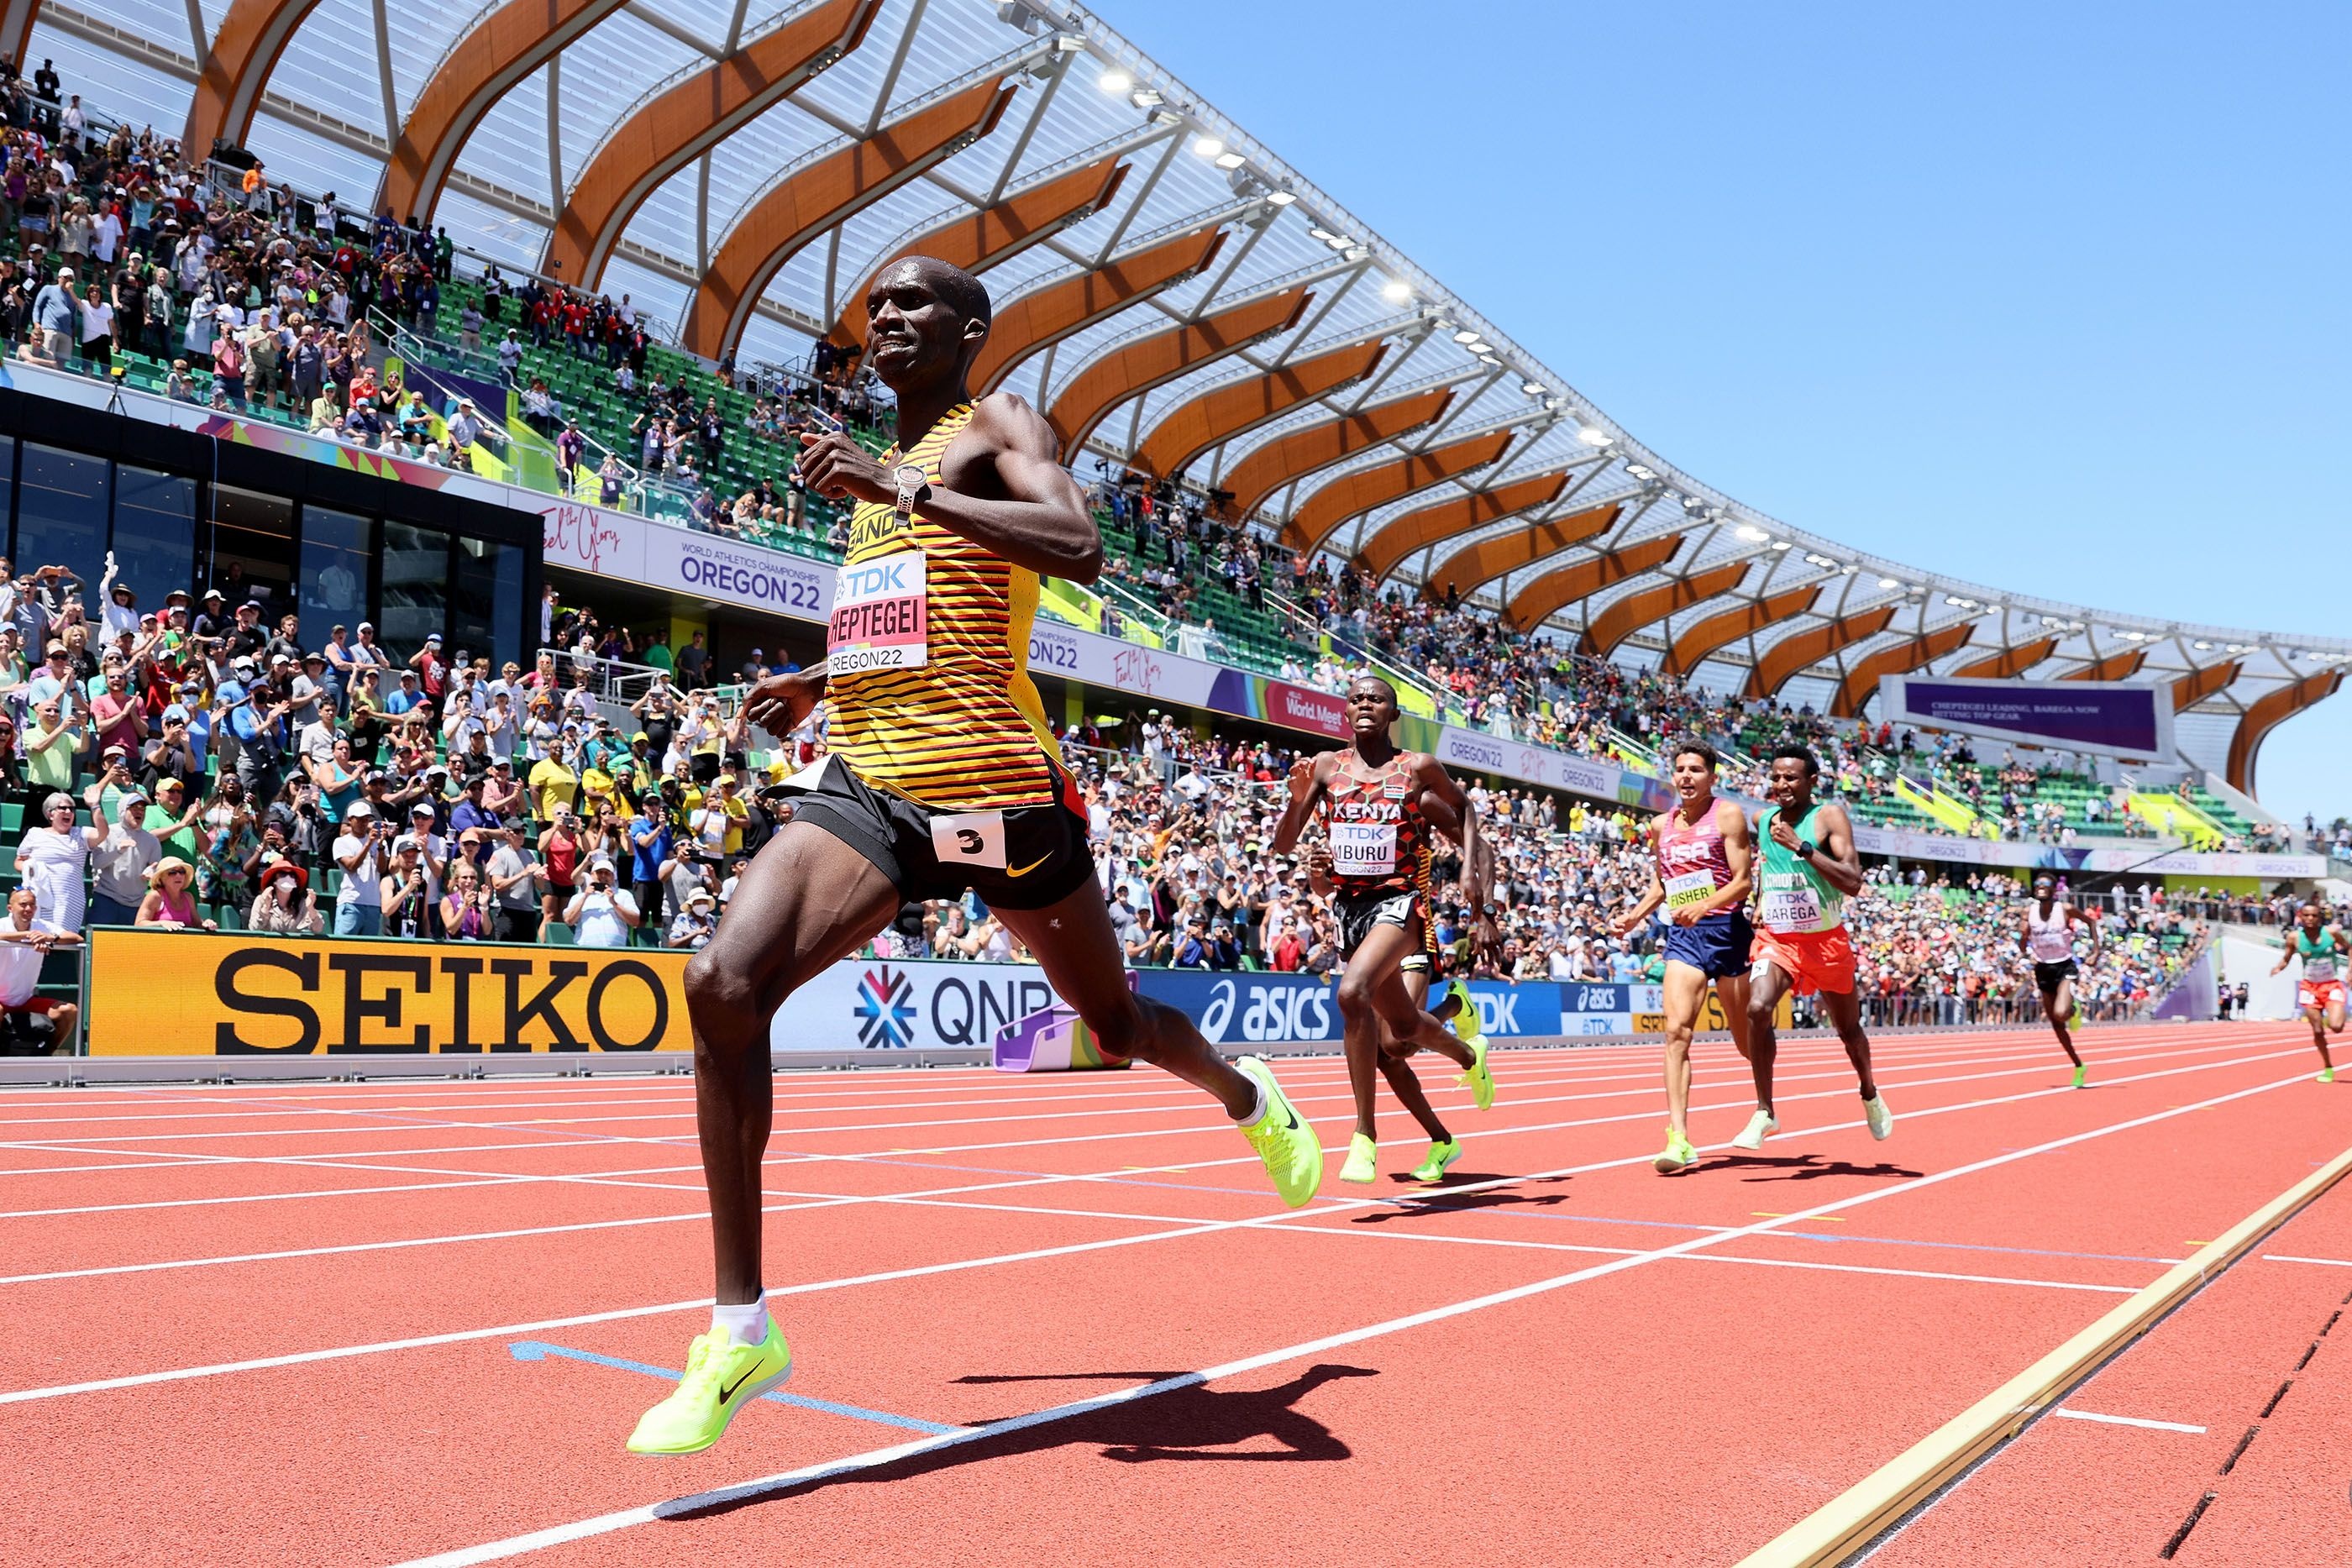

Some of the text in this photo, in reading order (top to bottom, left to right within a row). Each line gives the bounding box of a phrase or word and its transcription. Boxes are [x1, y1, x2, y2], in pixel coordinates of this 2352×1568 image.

[578, 507, 621, 573] Glory
[681, 543, 821, 585] WORLD ATHLETICS CHAMPIONSHIPS
[847, 563, 906, 597] TDK
[828, 600, 918, 647] HEPTEGEI
[1316, 705, 1342, 726] Meet
[1334, 802, 1401, 821] KENYA
[956, 829, 984, 854] 3
[1344, 826, 1385, 840] TDK
[1661, 841, 1711, 863] USA
[1676, 876, 1703, 888] TDK
[1671, 887, 1709, 908] FISHER
[1776, 893, 1809, 905] TDK
[1767, 905, 1817, 920] BAREGA
[214, 947, 669, 1056] SEIKO
[1589, 1019, 1614, 1035] TDK
